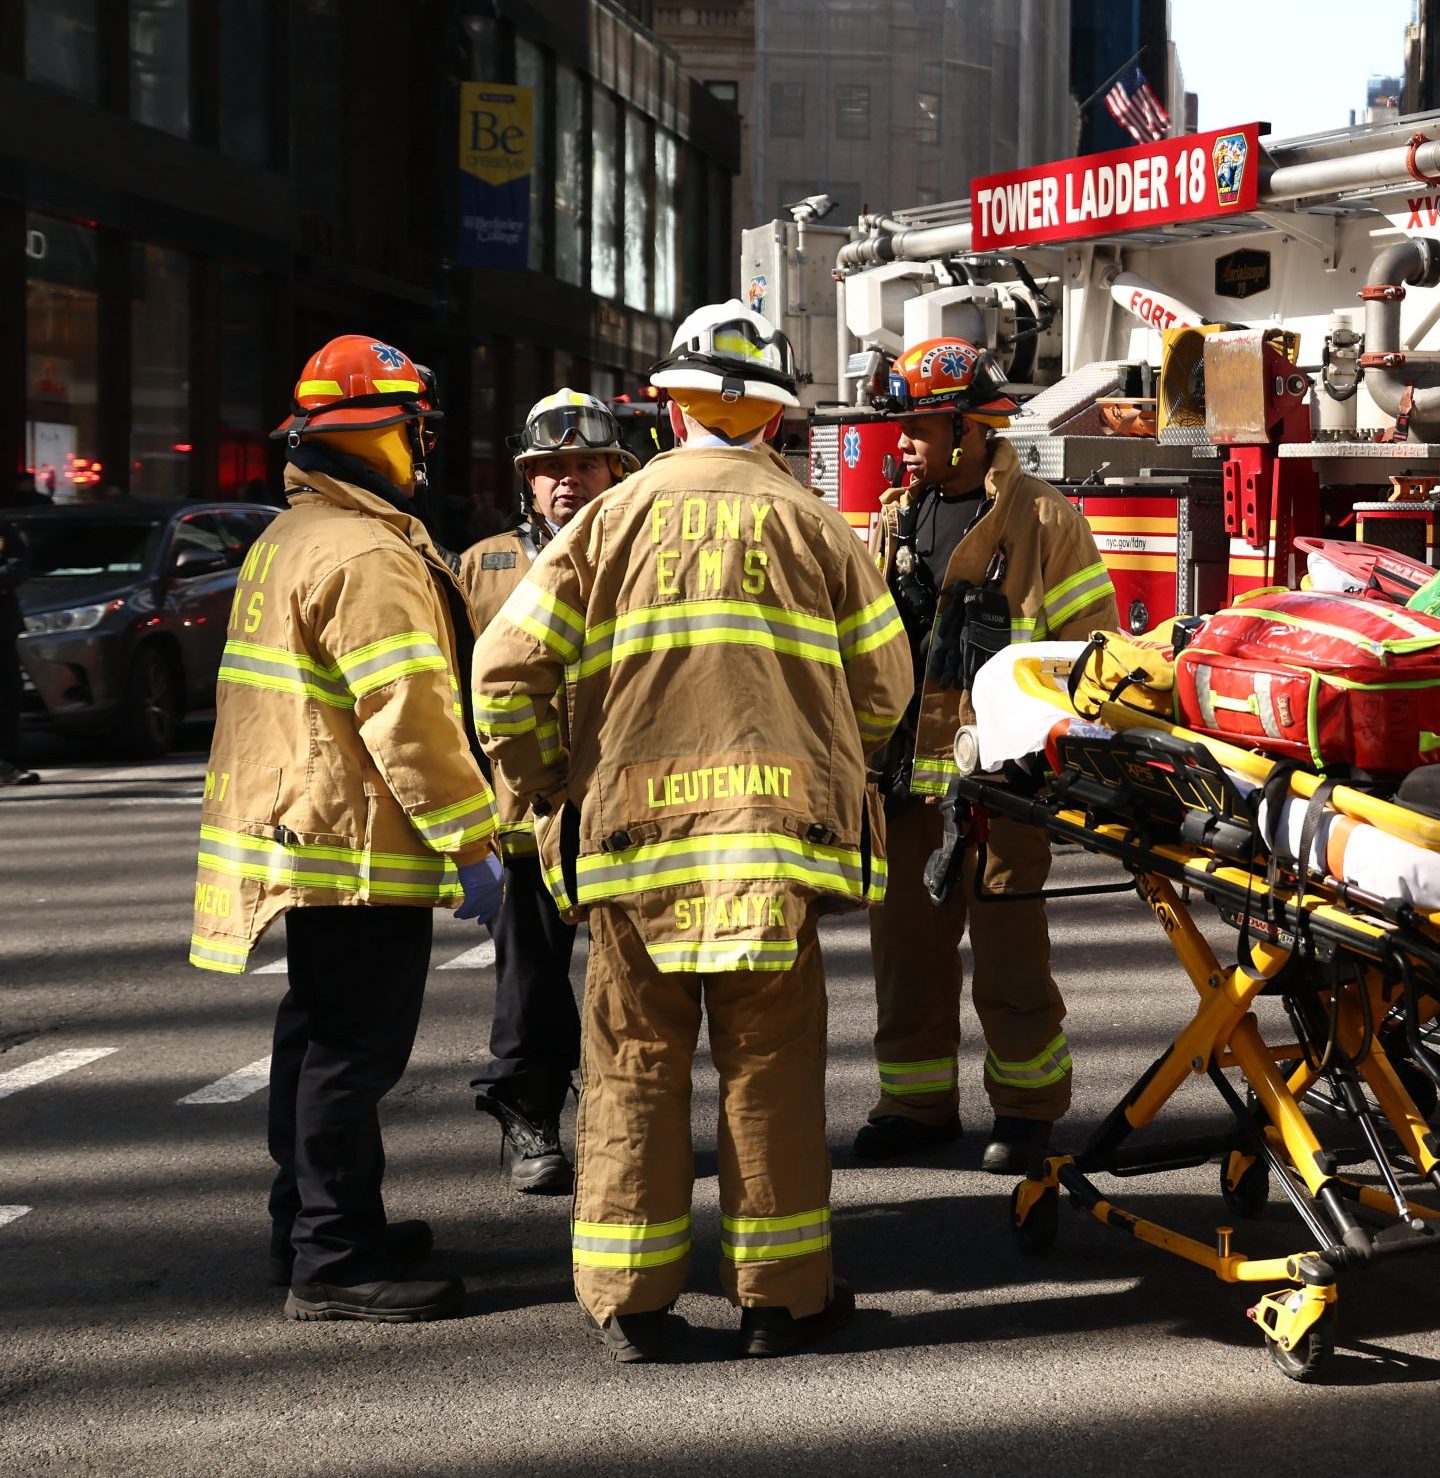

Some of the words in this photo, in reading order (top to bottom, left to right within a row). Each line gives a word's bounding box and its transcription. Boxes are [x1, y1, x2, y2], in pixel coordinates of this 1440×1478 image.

[466, 110, 526, 156] Be
[977, 176, 1060, 237] TOWER
[1065, 154, 1169, 224] LADDER
[1174, 146, 1207, 206] 18
[1129, 290, 1178, 329] FORT
[917, 393, 960, 405] COAST
[652, 497, 771, 544] FDNY
[240, 541, 280, 584] NY
[1105, 536, 1147, 551] nyc.gov/fdny
[656, 548, 769, 596] EMS
[647, 764, 793, 809] LIEUTENANT
